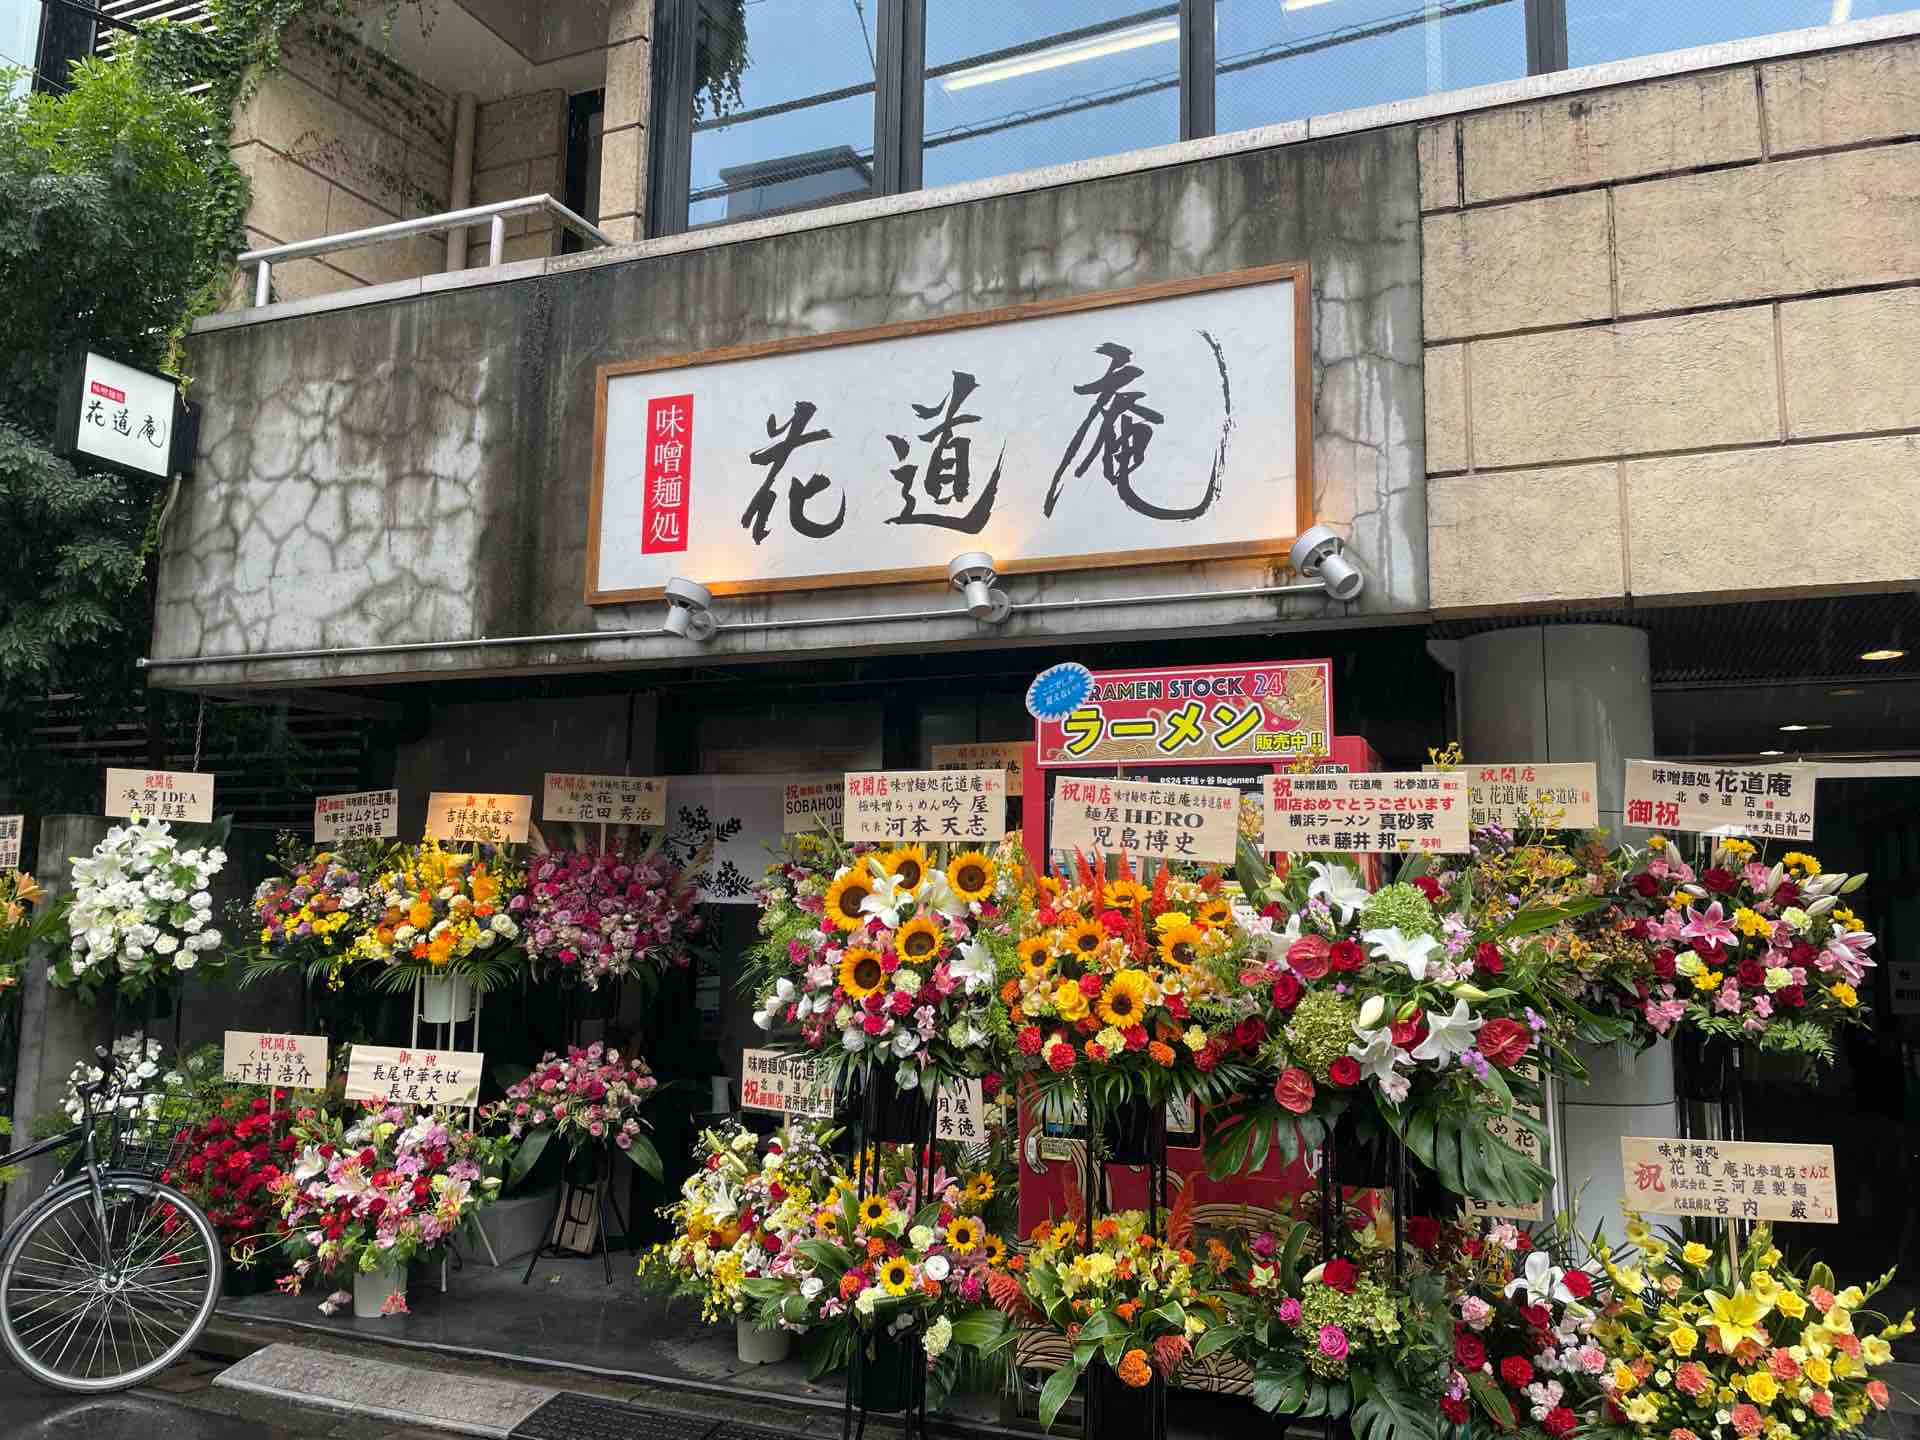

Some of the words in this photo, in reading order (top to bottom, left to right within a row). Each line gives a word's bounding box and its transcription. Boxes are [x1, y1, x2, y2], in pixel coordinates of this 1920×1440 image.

[86, 400, 167, 448] 花道庵
[740, 328, 1236, 546] 花道庵
[649, 404, 687, 547] 味噌麺処
[1088, 682, 1163, 701] RAMEN
[1169, 676, 1244, 698] STOCK
[1252, 672, 1283, 696] 24
[1063, 700, 1264, 755] ラーメン
[1480, 767, 1536, 784] 祝開店
[1652, 769, 1711, 788] 味噌麺処
[1714, 769, 1793, 797] 花道庵
[848, 776, 888, 797] 祝開店
[1061, 783, 1112, 805] 祝開店
[1272, 777, 1293, 798] 祝
[1489, 784, 1528, 805] 花道庵
[1273, 797, 1455, 812] 開店おめでとうございます
[1675, 791, 1755, 808] 北参道店
[1124, 808, 1204, 829] HERO
[1289, 814, 1371, 828] 横浜ラーメン
[1379, 813, 1435, 831] 真砂家
[1627, 799, 1680, 827] 御祝
[1092, 826, 1200, 855] 児島博史
[1306, 834, 1331, 847] 代表
[373, 1064, 461, 1084] 長尾中華そば
[389, 1083, 439, 1101] 長尾大
[1634, 1162, 1666, 1192] 祝
